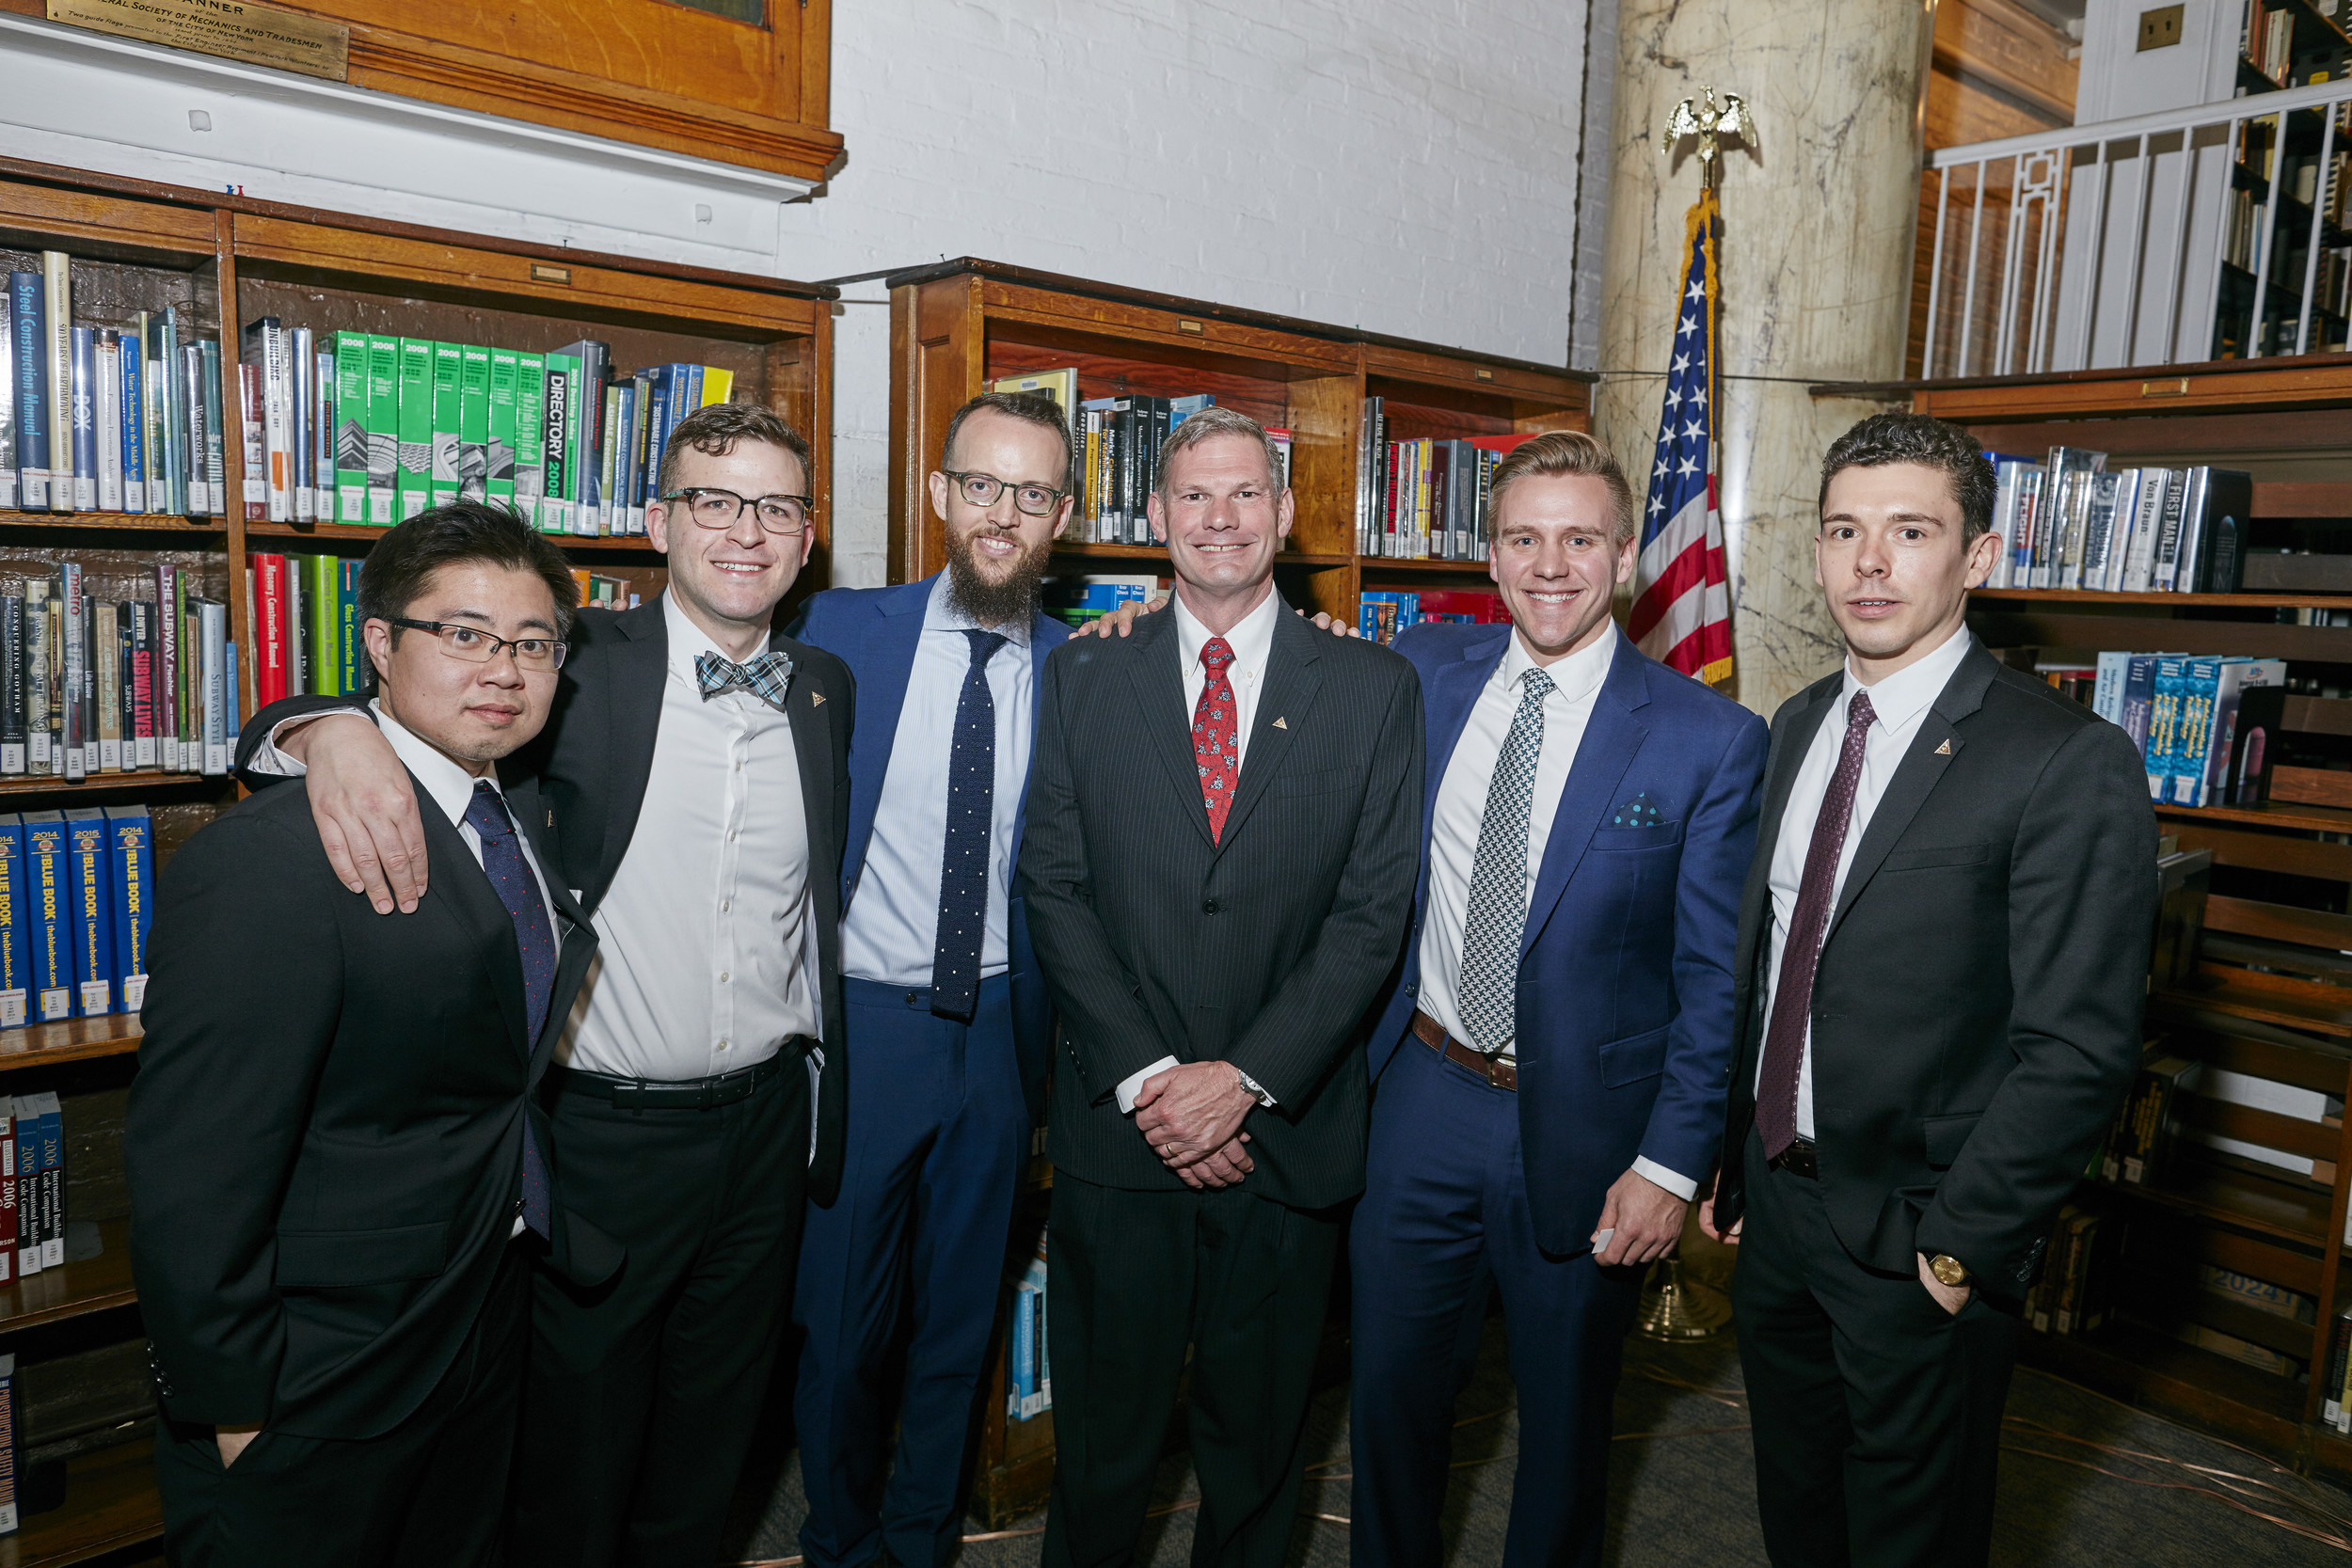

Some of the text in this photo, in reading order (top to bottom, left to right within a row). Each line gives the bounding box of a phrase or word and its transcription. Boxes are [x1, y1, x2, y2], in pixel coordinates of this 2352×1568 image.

[68, 9, 84, 19] Two
[84, 14, 105, 24] guide
[175, 33, 194, 41] First
[195, 37, 227, 49] Engineer
[227, 44, 258, 55] Regiment
[131, 2, 173, 17] SOCIETY
[188, 14, 242, 33] MECHANICS
[243, 27, 264, 38] AND
[265, 30, 324, 50] TRADESMEN
[167, 19, 184, 28] THE
[184, 23, 205, 33] CITY
[217, 29, 236, 39] NEW
[235, 34, 255, 43] YORK
[176, 0, 244, 16] ANNER
[20, 286, 40, 436] Steel Construction Manual
[269, 327, 280, 382] UNBUILDING
[341, 338, 365, 348] 2008
[372, 341, 395, 351] 2008
[405, 344, 429, 355] 2008
[437, 348, 460, 358] 2008
[466, 352, 487, 361] 2008
[494, 355, 516, 364] 2008
[520, 358, 542, 368] 2008
[58, 324, 71, 421] 500 YEARS OF EARTHMOVING
[74, 396, 91, 432] BOX
[569, 388, 578, 420] Desktop
[674, 377, 685, 420] SUSTAINABLE
[195, 405, 205, 465] Waterworks
[548, 375, 564, 498] DIRECTORY 2008
[602, 404, 615, 484] ASHRAE GreenGuide
[649, 407, 661, 485] SUSTAINABLE CONSTRUCTION
[130, 467, 138, 482] Ages
[1388, 444, 1399, 533] NEWTON's TELECOM DICTIO
[2017, 497, 2030, 546] FLIGHT
[2141, 480, 2159, 536] Von Braun:
[2163, 486, 2183, 545] FIRST MAN
[70, 574, 83, 616] metro
[165, 576, 174, 602] THE
[165, 604, 175, 661] SUBWAY
[265, 565, 279, 668] Masonry Construction Manual
[325, 569, 335, 668] Concrete Construction Manual
[134, 604, 152, 737] JIM DWYER SUBWAY LIVES
[345, 605, 356, 691] Glass Construction Manual
[36, 612, 45, 733] GRAND CENTRAL TERMINAL
[2109, 669, 2118, 694] Modern
[104, 692, 116, 730] Subways
[212, 674, 223, 745] SUBWAY STYLE
[2150, 694, 2163, 737] Technology
[2153, 707, 2169, 756] Conditioning
[2181, 696, 2194, 739] Technology
[2185, 710, 2201, 758] Conditioning
[74, 830, 100, 838] 2015
[0, 863, 12, 927] BLUE BOOK
[84, 857, 97, 919] BLUE BOOK
[127, 853, 140, 914] BLUE BOOK
[42, 859, 57, 987] BLUE BOOK thebluebook.com
[23, 1145, 35, 1173] 2006
[44, 1138, 57, 1166] 2006
[4, 1180, 16, 1210] 2006
[19, 1180, 29, 1237] Code Companion
[30, 1179, 40, 1221] International
[41, 1172, 52, 1229] Code Companion
[53, 1170, 62, 1239] International Buildin
